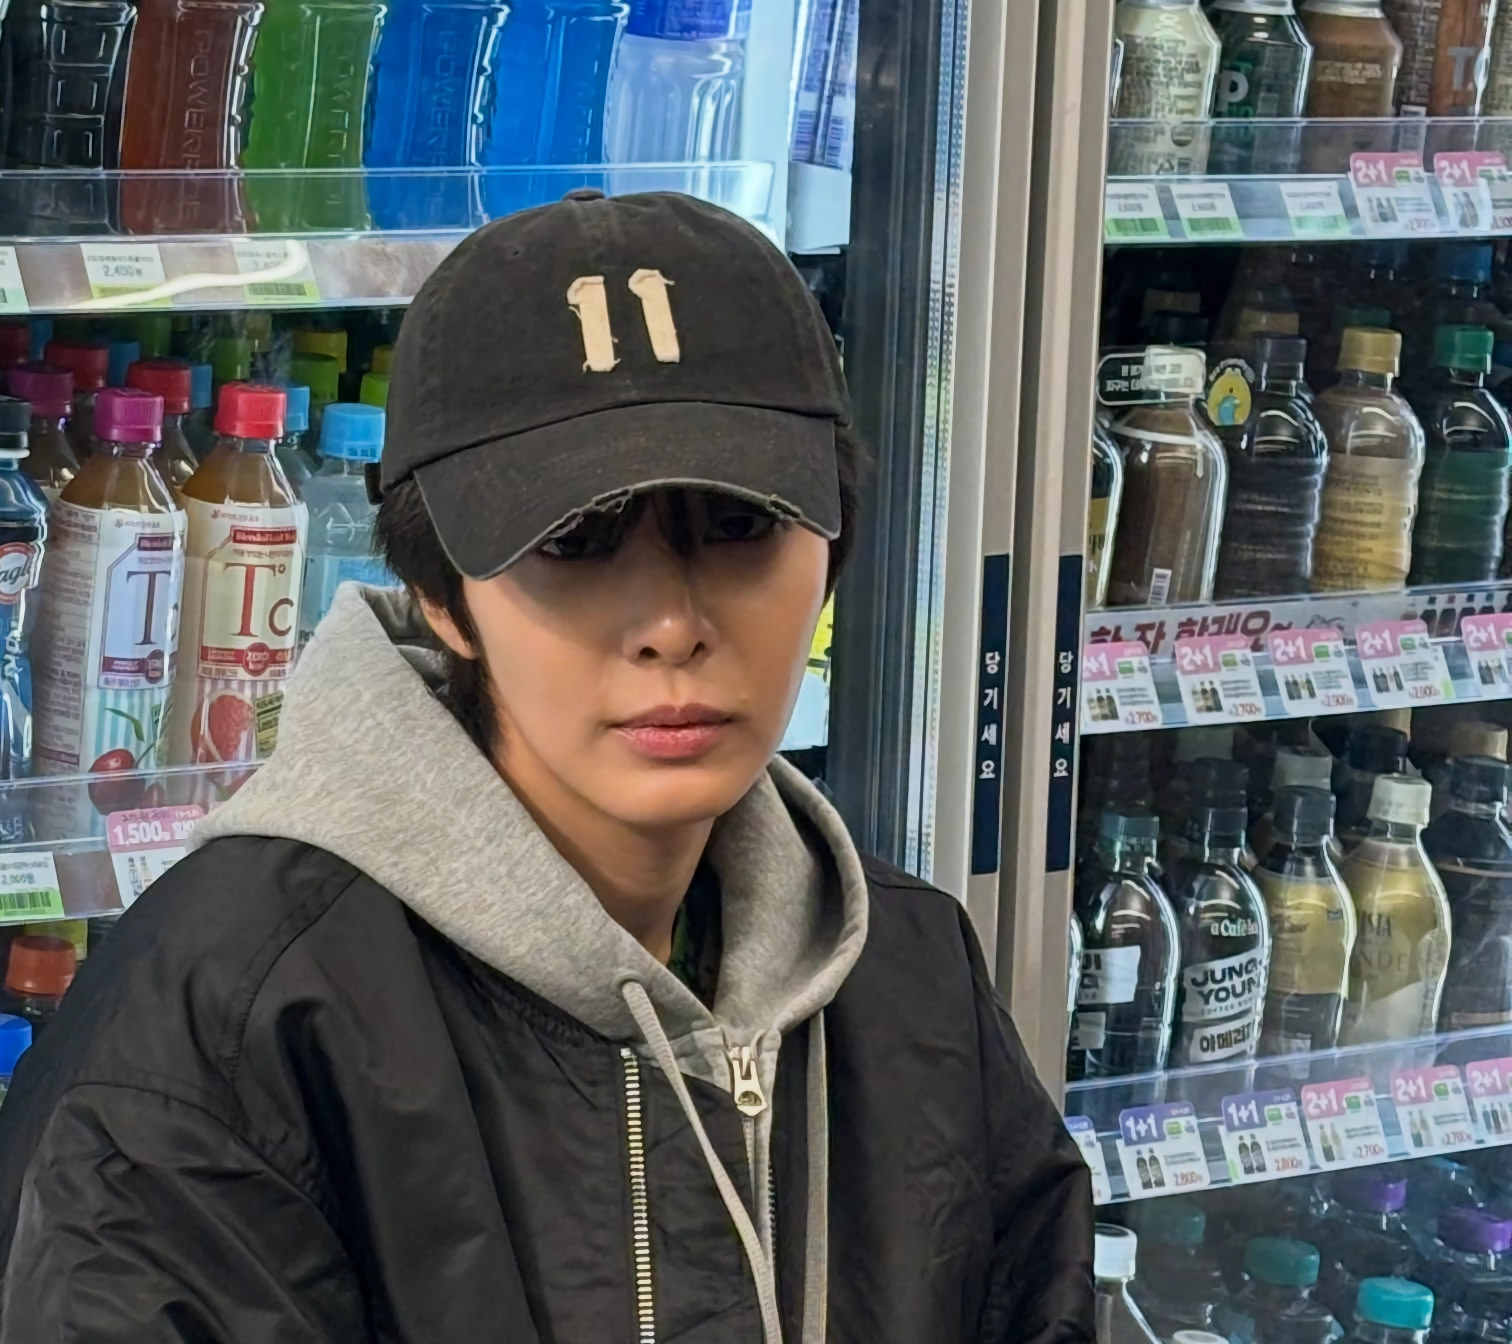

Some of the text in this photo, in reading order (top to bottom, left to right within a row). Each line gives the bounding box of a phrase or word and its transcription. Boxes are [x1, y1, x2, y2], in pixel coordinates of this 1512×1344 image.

[1355, 158, 1389, 184] 2+1
[1361, 629, 1394, 656] 2+1
[1467, 622, 1499, 648] 2+1
[1180, 644, 1214, 671] 2+1
[1273, 636, 1308, 663] 2+1
[979, 651, 1001, 780] 당기세요
[1053, 650, 1074, 779] 당기세요
[1190, 959, 1259, 989] JUNG
[1197, 977, 1264, 1006] YOUN
[1395, 1075, 1428, 1102] 2+1
[1473, 1067, 1503, 1094] 2+1
[1227, 1099, 1261, 1128] 1+1
[1305, 1087, 1339, 1116] 2+1
[1125, 1112, 1159, 1142] 1+1
